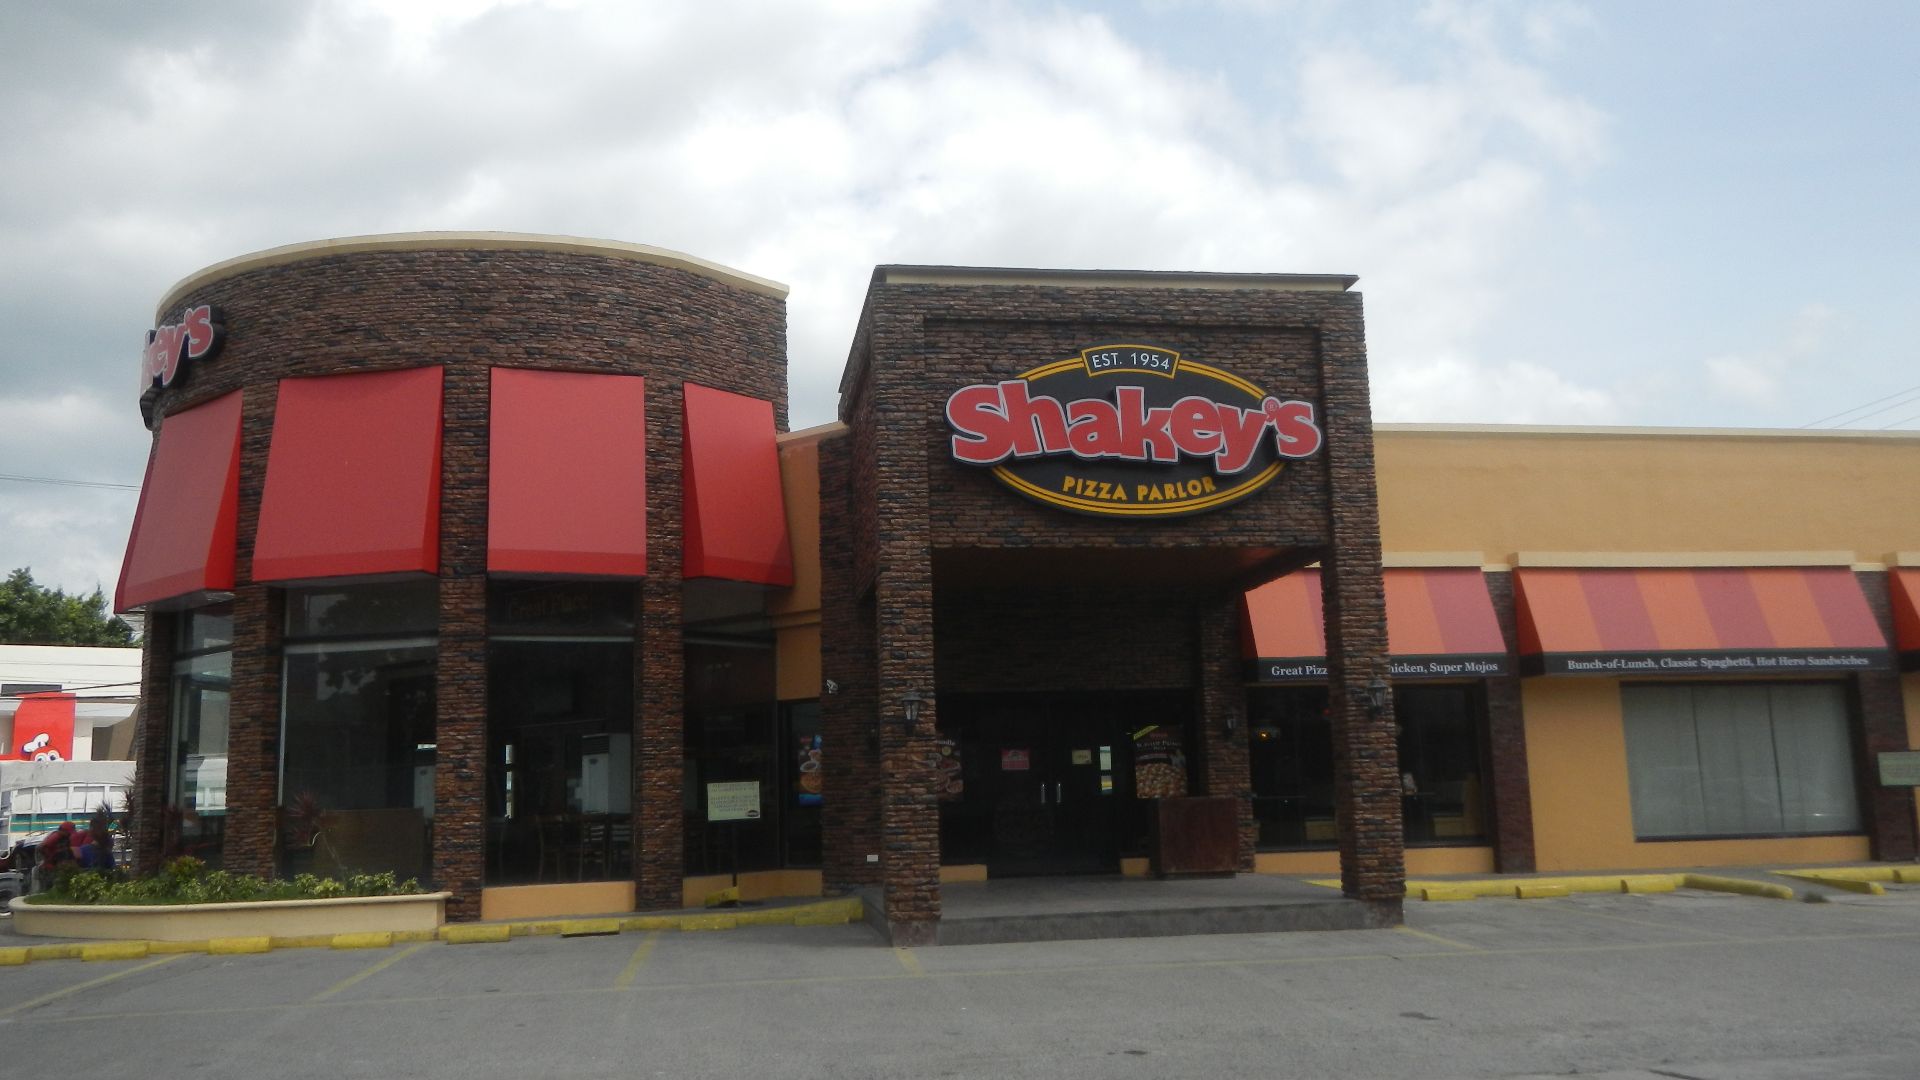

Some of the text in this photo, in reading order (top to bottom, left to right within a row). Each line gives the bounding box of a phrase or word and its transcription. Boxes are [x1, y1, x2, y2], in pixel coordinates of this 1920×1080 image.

[1091, 351, 1170, 370] EST. 1954
[945, 379, 1321, 474] Shakey's
[1062, 475, 1216, 501] PIZZA PARLOR
[1271, 666, 1303, 676] Great
[1305, 665, 1329, 675] Pizz
[1429, 661, 1463, 674] Super
[1464, 661, 1498, 673] Mojos
[1567, 655, 1869, 670] Bunch-of-Lunch, Classic Spaghetti, Hot Hero Sandwiches
